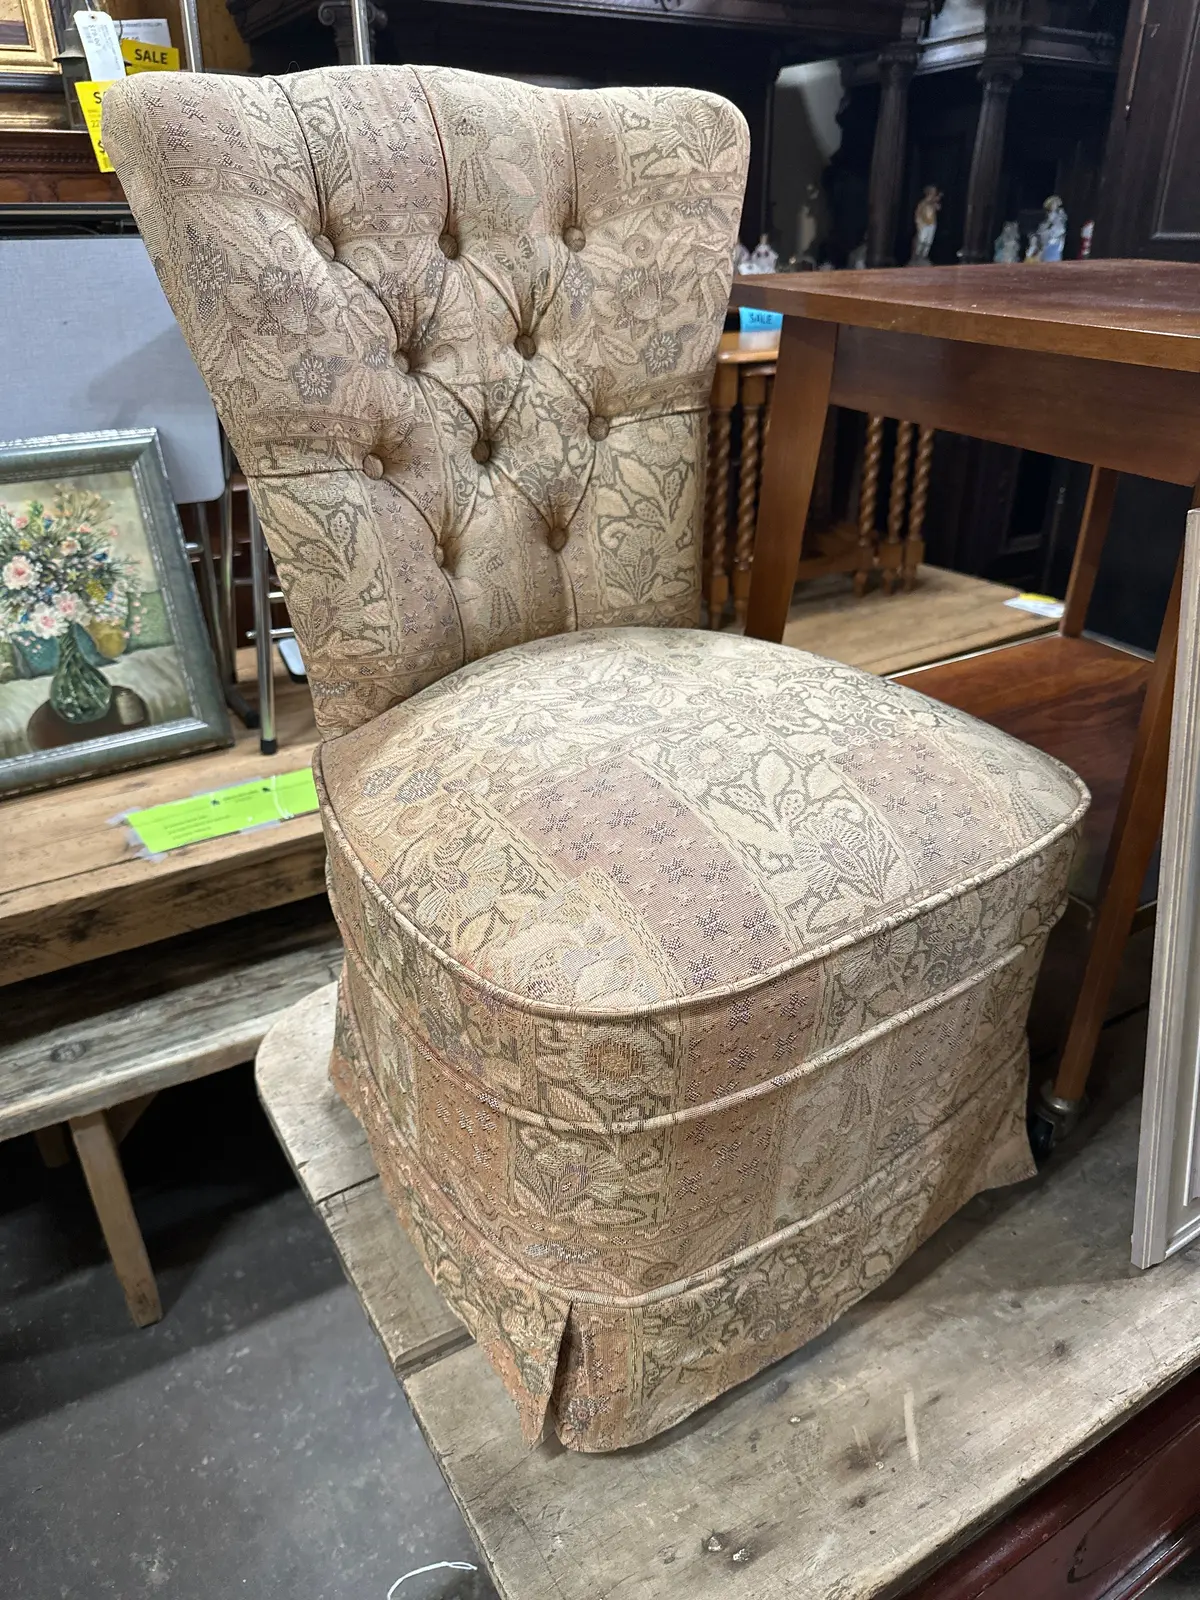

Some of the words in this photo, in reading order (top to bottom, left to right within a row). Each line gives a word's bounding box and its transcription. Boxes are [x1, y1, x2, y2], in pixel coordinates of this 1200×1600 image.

[134, 48, 169, 64] SALE
[93, 91, 106, 104] S
[749, 312, 773, 325] SALE
